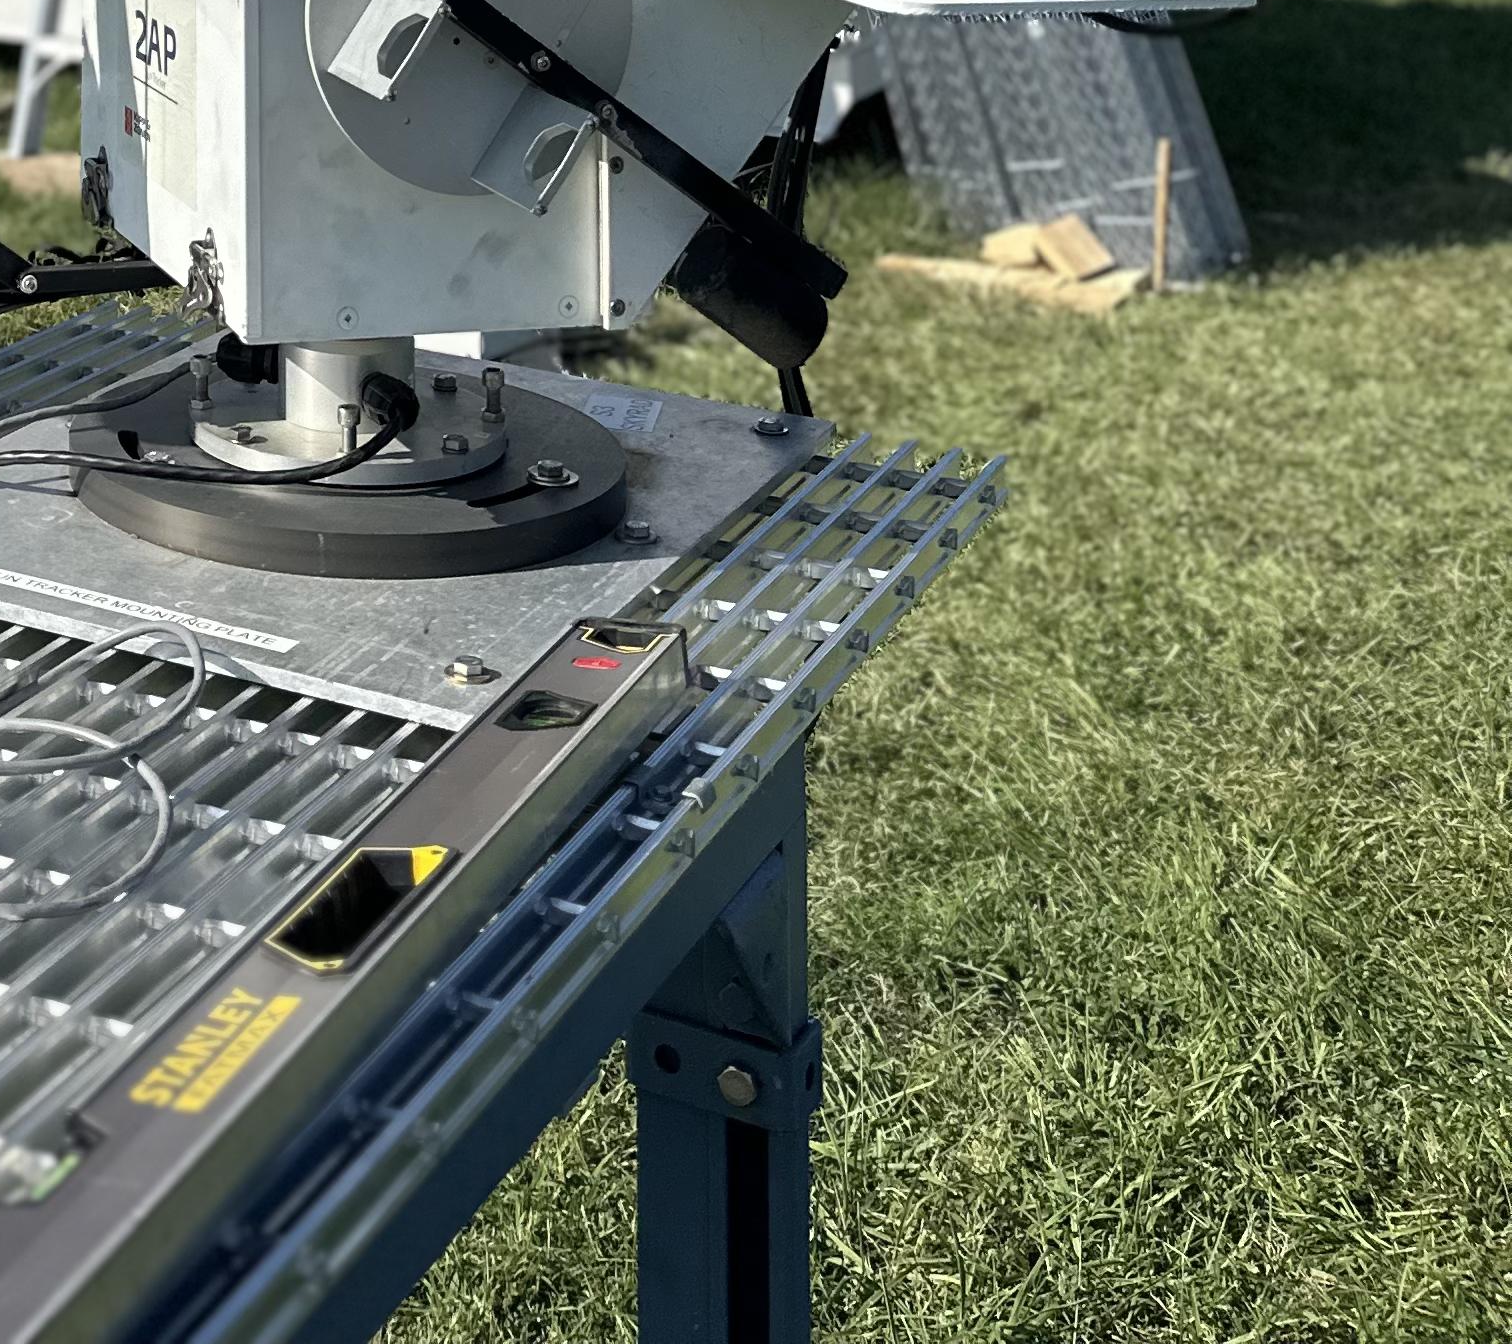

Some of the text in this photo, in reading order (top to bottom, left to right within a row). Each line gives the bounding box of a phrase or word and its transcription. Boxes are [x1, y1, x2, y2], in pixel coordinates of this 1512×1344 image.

[135, 9, 177, 77] 2AP
[25, 578, 109, 604] TRACKER
[110, 600, 213, 630] MOUNTING
[214, 625, 277, 646] PLATE
[129, 986, 264, 1107] STANLEY
